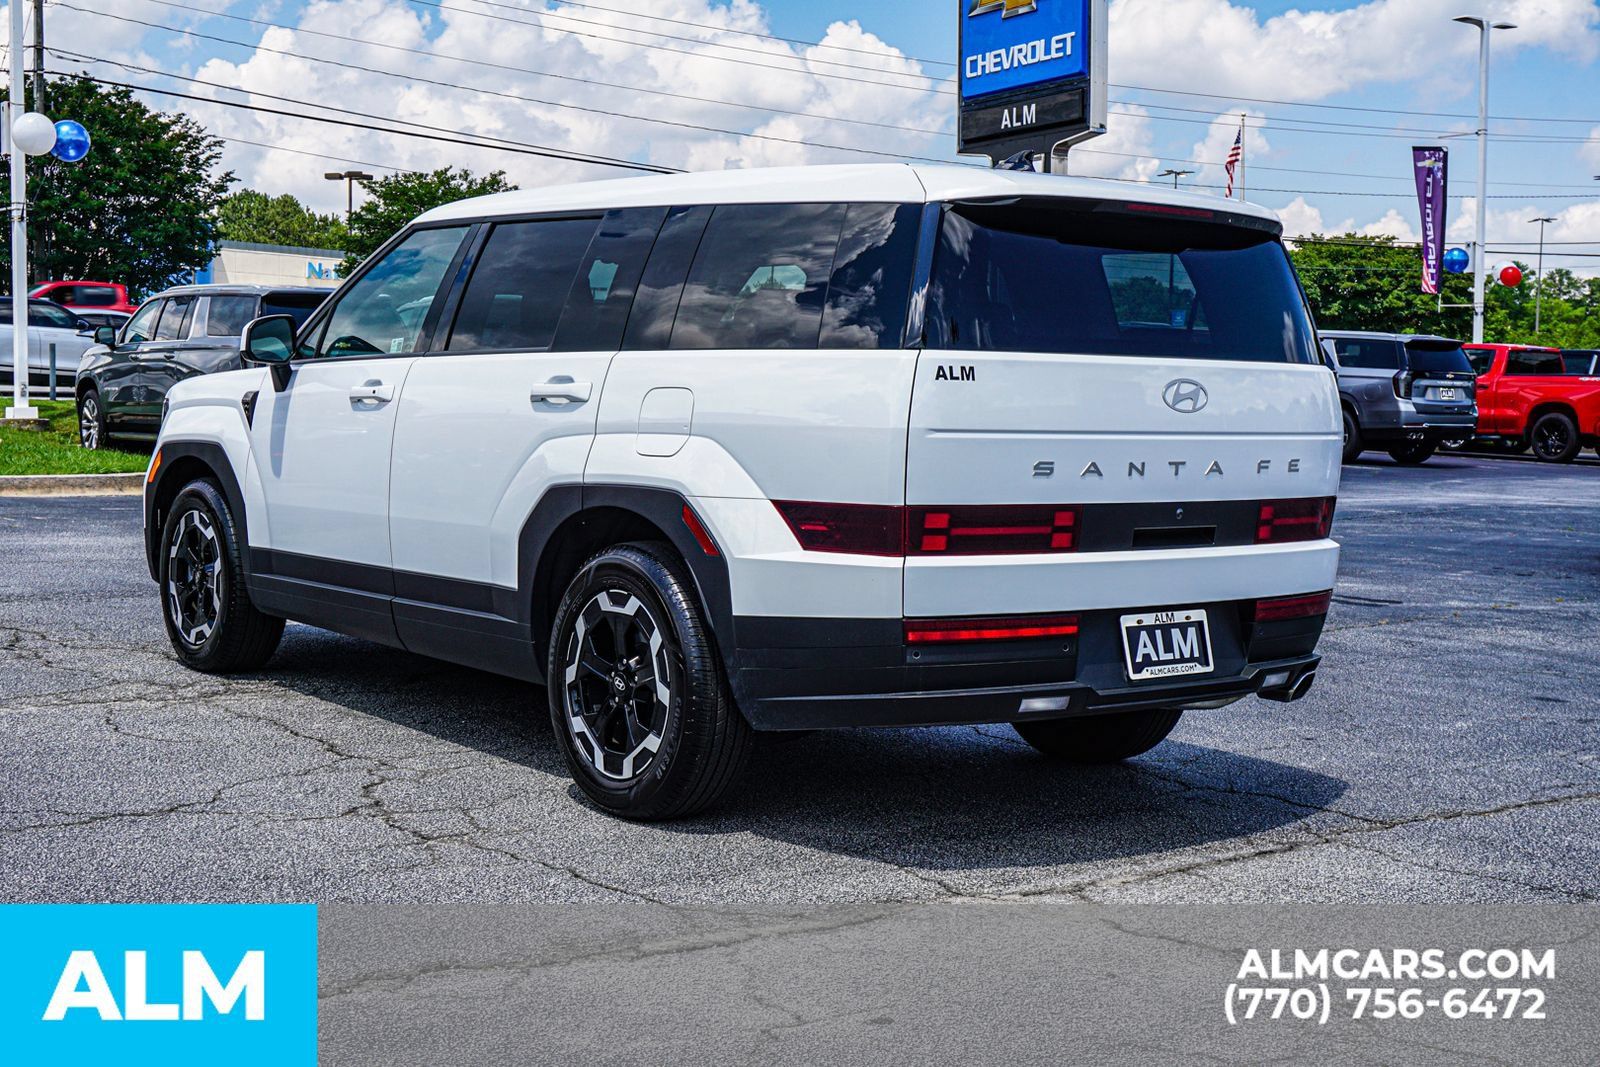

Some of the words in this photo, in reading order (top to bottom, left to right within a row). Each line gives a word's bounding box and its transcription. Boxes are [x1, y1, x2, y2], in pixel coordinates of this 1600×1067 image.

[966, 31, 1076, 79] CHEVROLET
[1001, 103, 1036, 129] ALM
[935, 365, 976, 381] ALM
[1032, 460, 1224, 477] SANTA
[1256, 458, 1300, 473] FE
[1154, 612, 1175, 623] ALM
[1135, 627, 1200, 663] ALM
[1150, 665, 1195, 676] ALMCARS.COM
